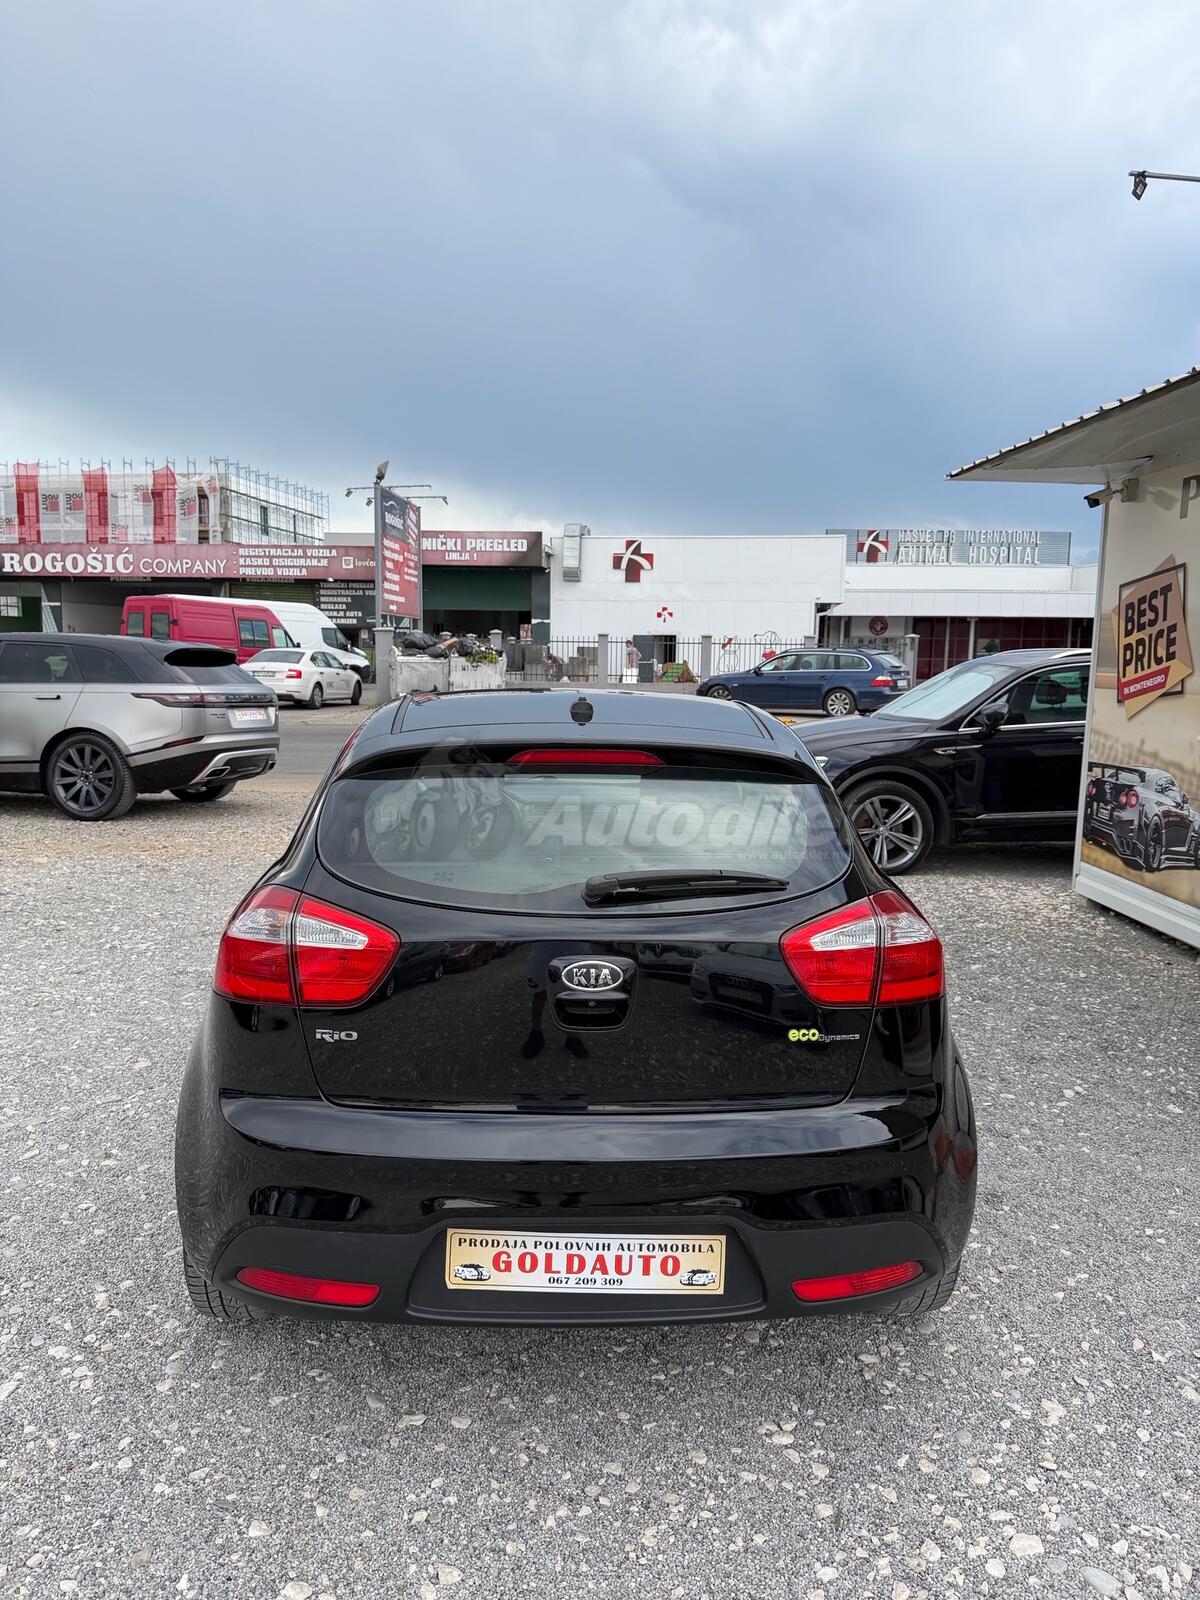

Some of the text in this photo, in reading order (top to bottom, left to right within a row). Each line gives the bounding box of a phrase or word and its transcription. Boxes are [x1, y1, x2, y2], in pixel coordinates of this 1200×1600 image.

[422, 534, 528, 552] NIČKI PREGLED
[964, 530, 1041, 543] INTERNATIONAL
[2, 547, 227, 574] ROGOŠIĆ COMPANY
[239, 548, 337, 557] REGISTRACIJA VOZILA
[445, 552, 470, 560] LINIJA
[898, 545, 1040, 564] ANIMAL HOSPITAL
[239, 558, 329, 567] KASKO OSIGURANJE
[239, 567, 307, 576] PREVOD VOZILA
[1124, 582, 1173, 638] BEST
[1122, 622, 1177, 678] PRICE
[1123, 674, 1166, 695] IN MONTENEGRO
[573, 968, 613, 986] KIA
[458, 1237, 715, 1254] PRODAJA POLOVNIH AUTOMOBILA
[492, 1251, 681, 1277] GOLDAUTO
[548, 1276, 623, 1287] 067 209 309
